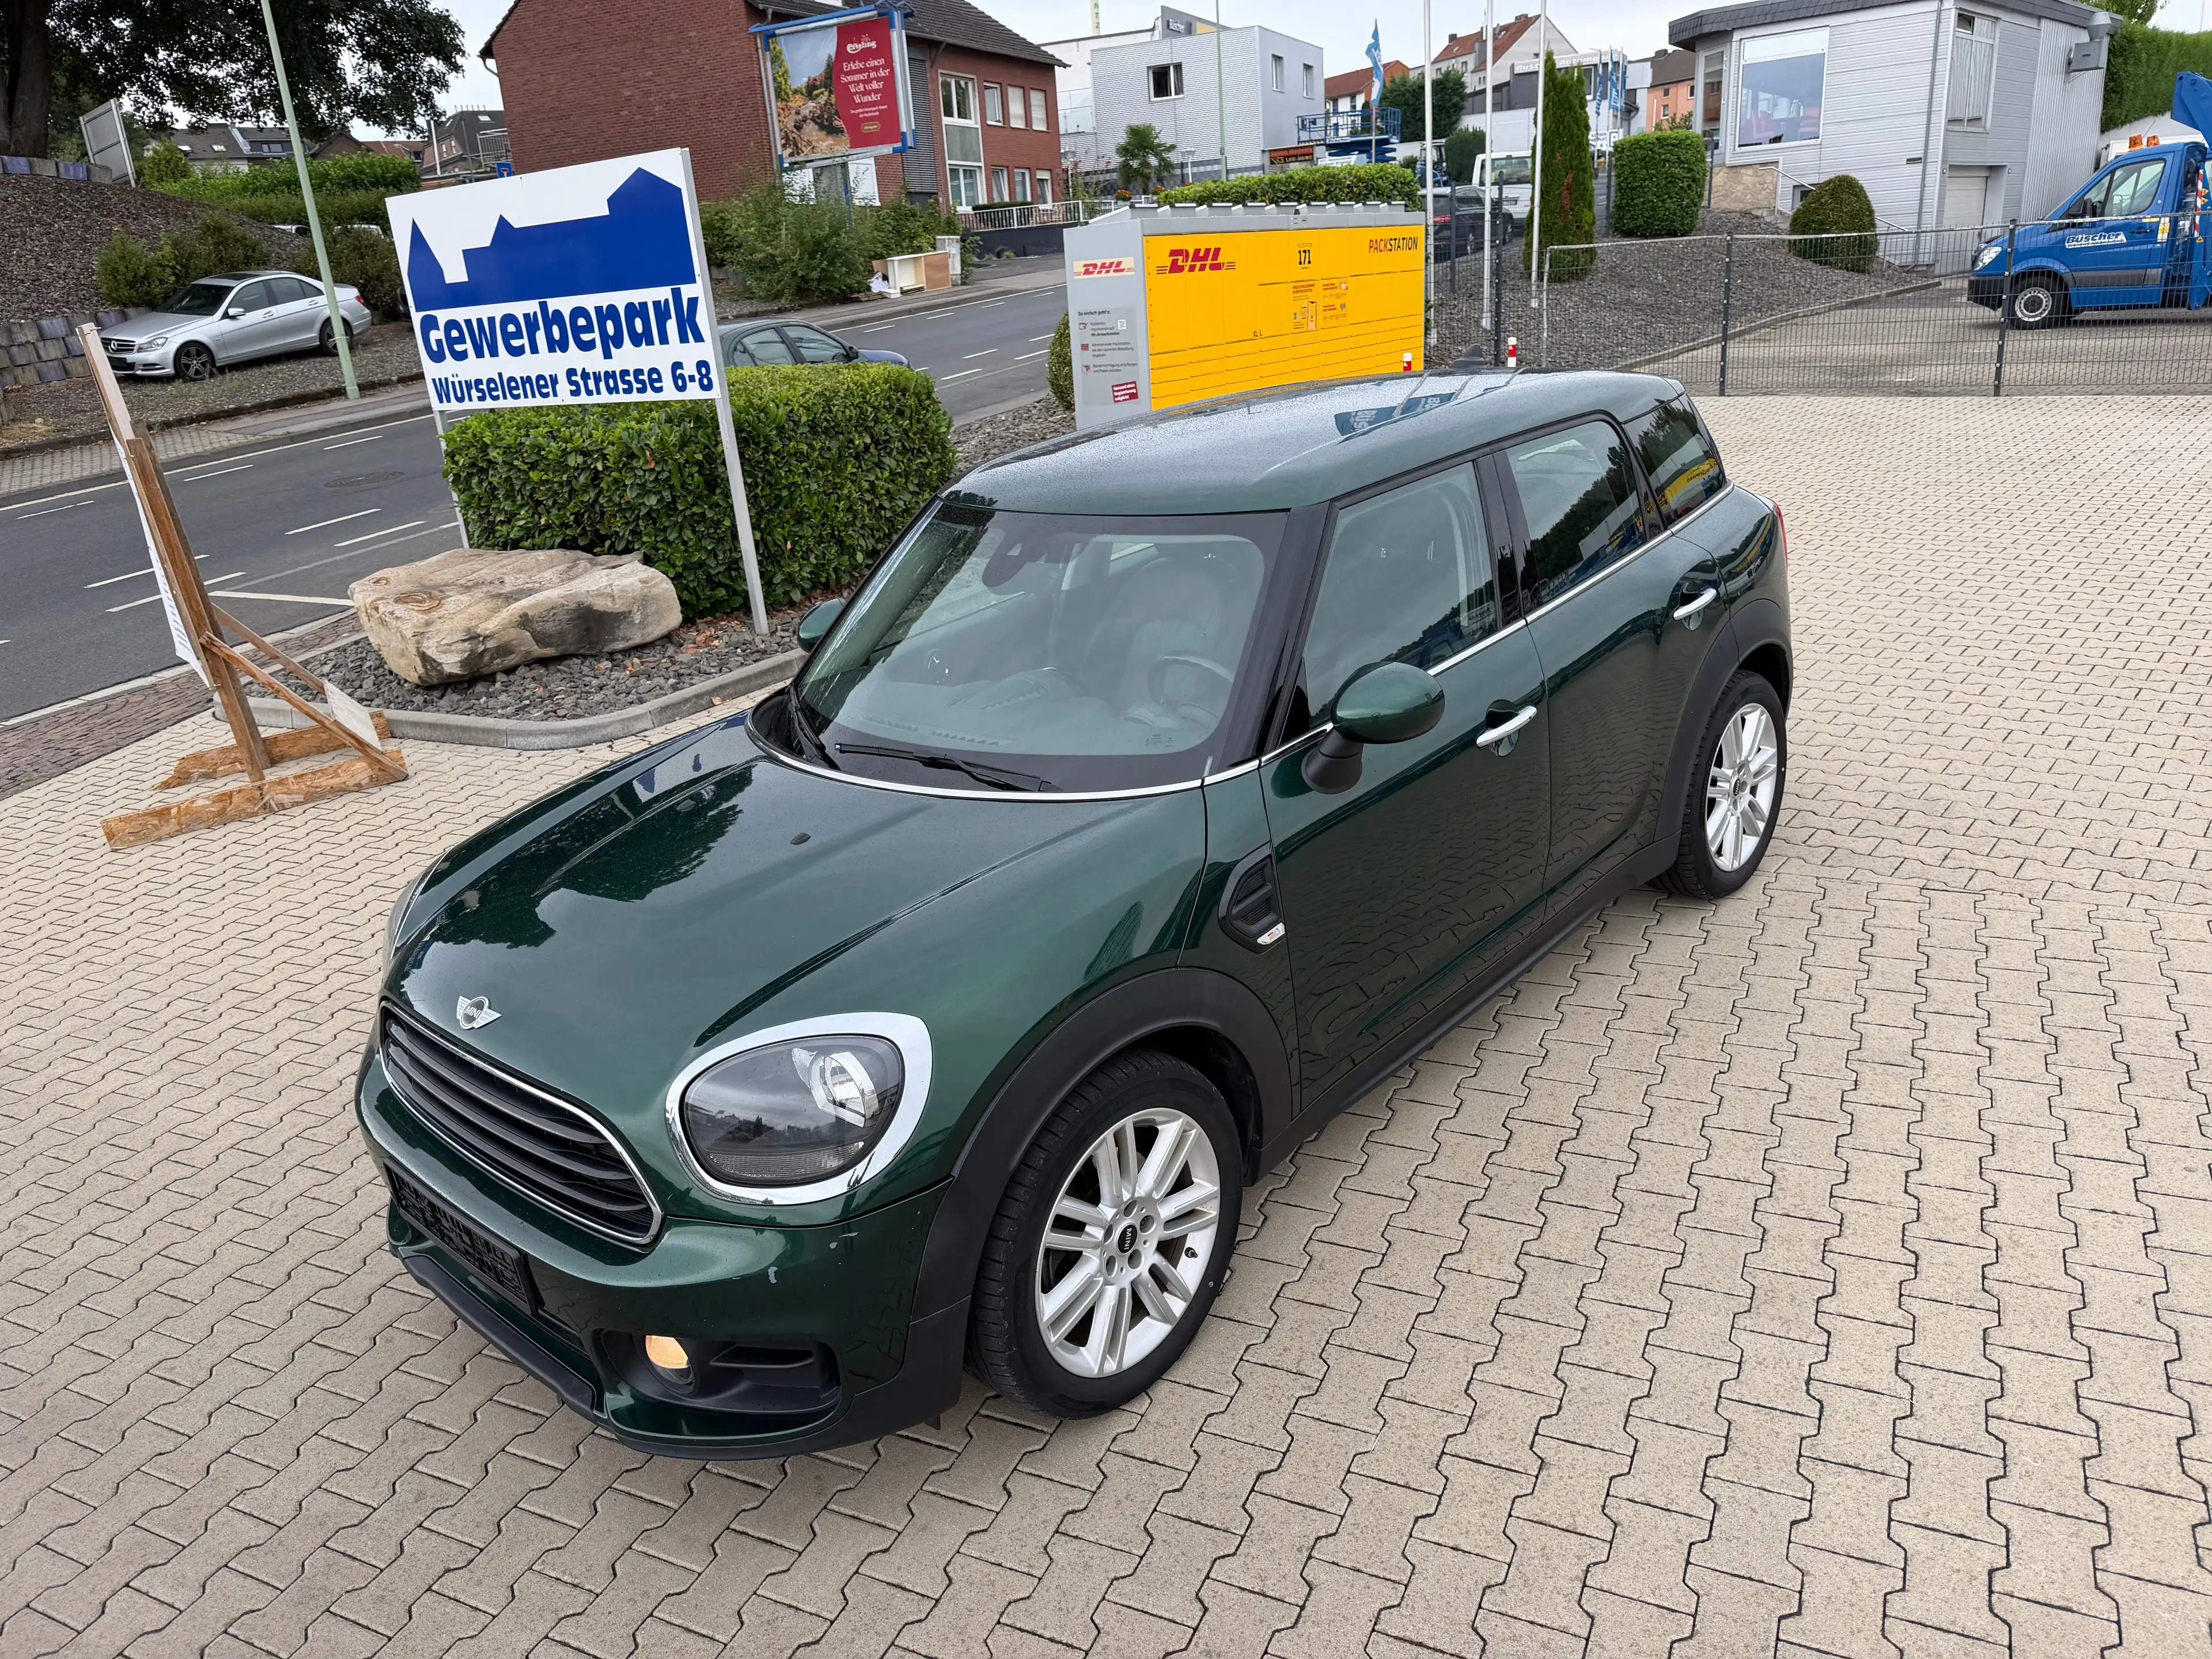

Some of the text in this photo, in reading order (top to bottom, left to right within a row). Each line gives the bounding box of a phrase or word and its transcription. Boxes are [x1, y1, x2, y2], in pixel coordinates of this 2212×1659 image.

[843, 58, 885, 71] Erlebe einen
[840, 67, 890, 83] Sommer in der
[849, 80, 884, 93] Welt voller
[853, 92, 882, 103] Wunder
[1369, 237, 1418, 253] PACKSTATION
[2067, 232, 2122, 244] Büscher
[1168, 248, 1225, 274] DHL
[1298, 249, 1311, 265] 171
[1082, 261, 1126, 275] DHL
[420, 287, 705, 363] Gewerbepark
[432, 360, 714, 404] Würselener Strasse 6-8
[464, 1005, 482, 1018] MINI
